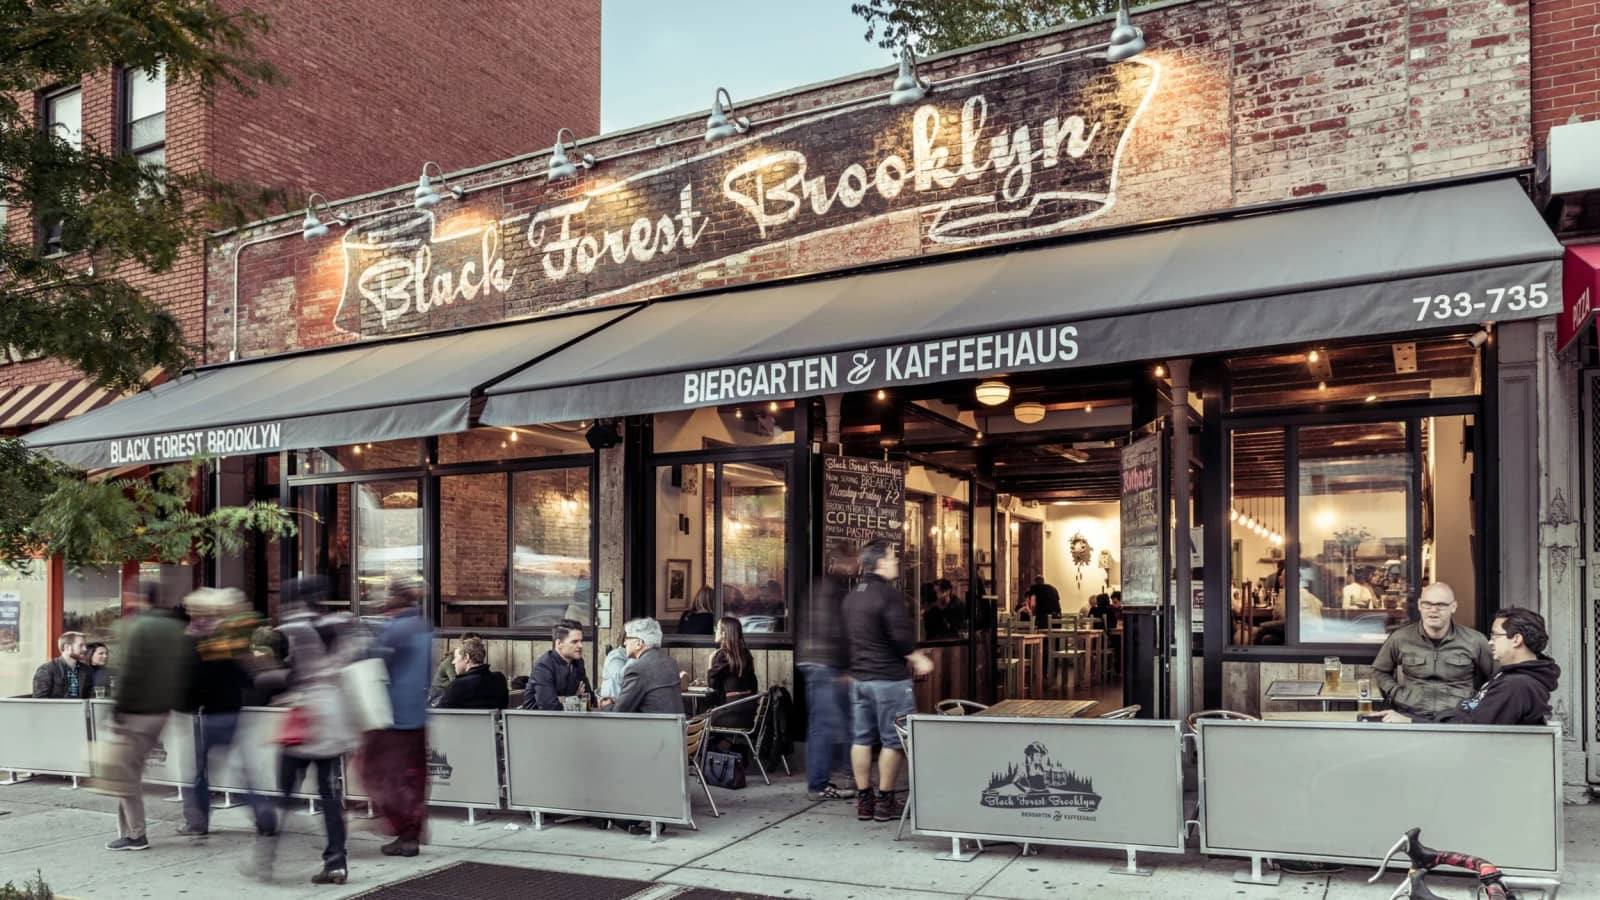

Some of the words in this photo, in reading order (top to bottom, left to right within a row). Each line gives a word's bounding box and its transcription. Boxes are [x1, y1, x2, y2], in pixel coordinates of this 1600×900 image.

[358, 223, 517, 330] Black
[527, 183, 710, 280] Forest
[723, 94, 1102, 239] Brooklyn
[1412, 282, 1549, 322] 733-735
[1572, 286, 1591, 332] PIZZA
[683, 356, 838, 405] BIERGARTEN
[846, 350, 877, 385] &
[885, 326, 1079, 382] KAFFEEHAUS
[110, 438, 152, 464] BLACK
[153, 431, 204, 460] FOREST
[207, 422, 281, 454] BROOKLYN
[825, 457, 847, 470] Black
[869, 460, 902, 480] Brooklyn
[826, 511, 888, 530] COFFEE
[847, 527, 875, 540] PASTRY
[984, 795, 1014, 807] Black
[1017, 794, 1045, 806] Forest
[1048, 794, 1096, 809] Brooklyn
